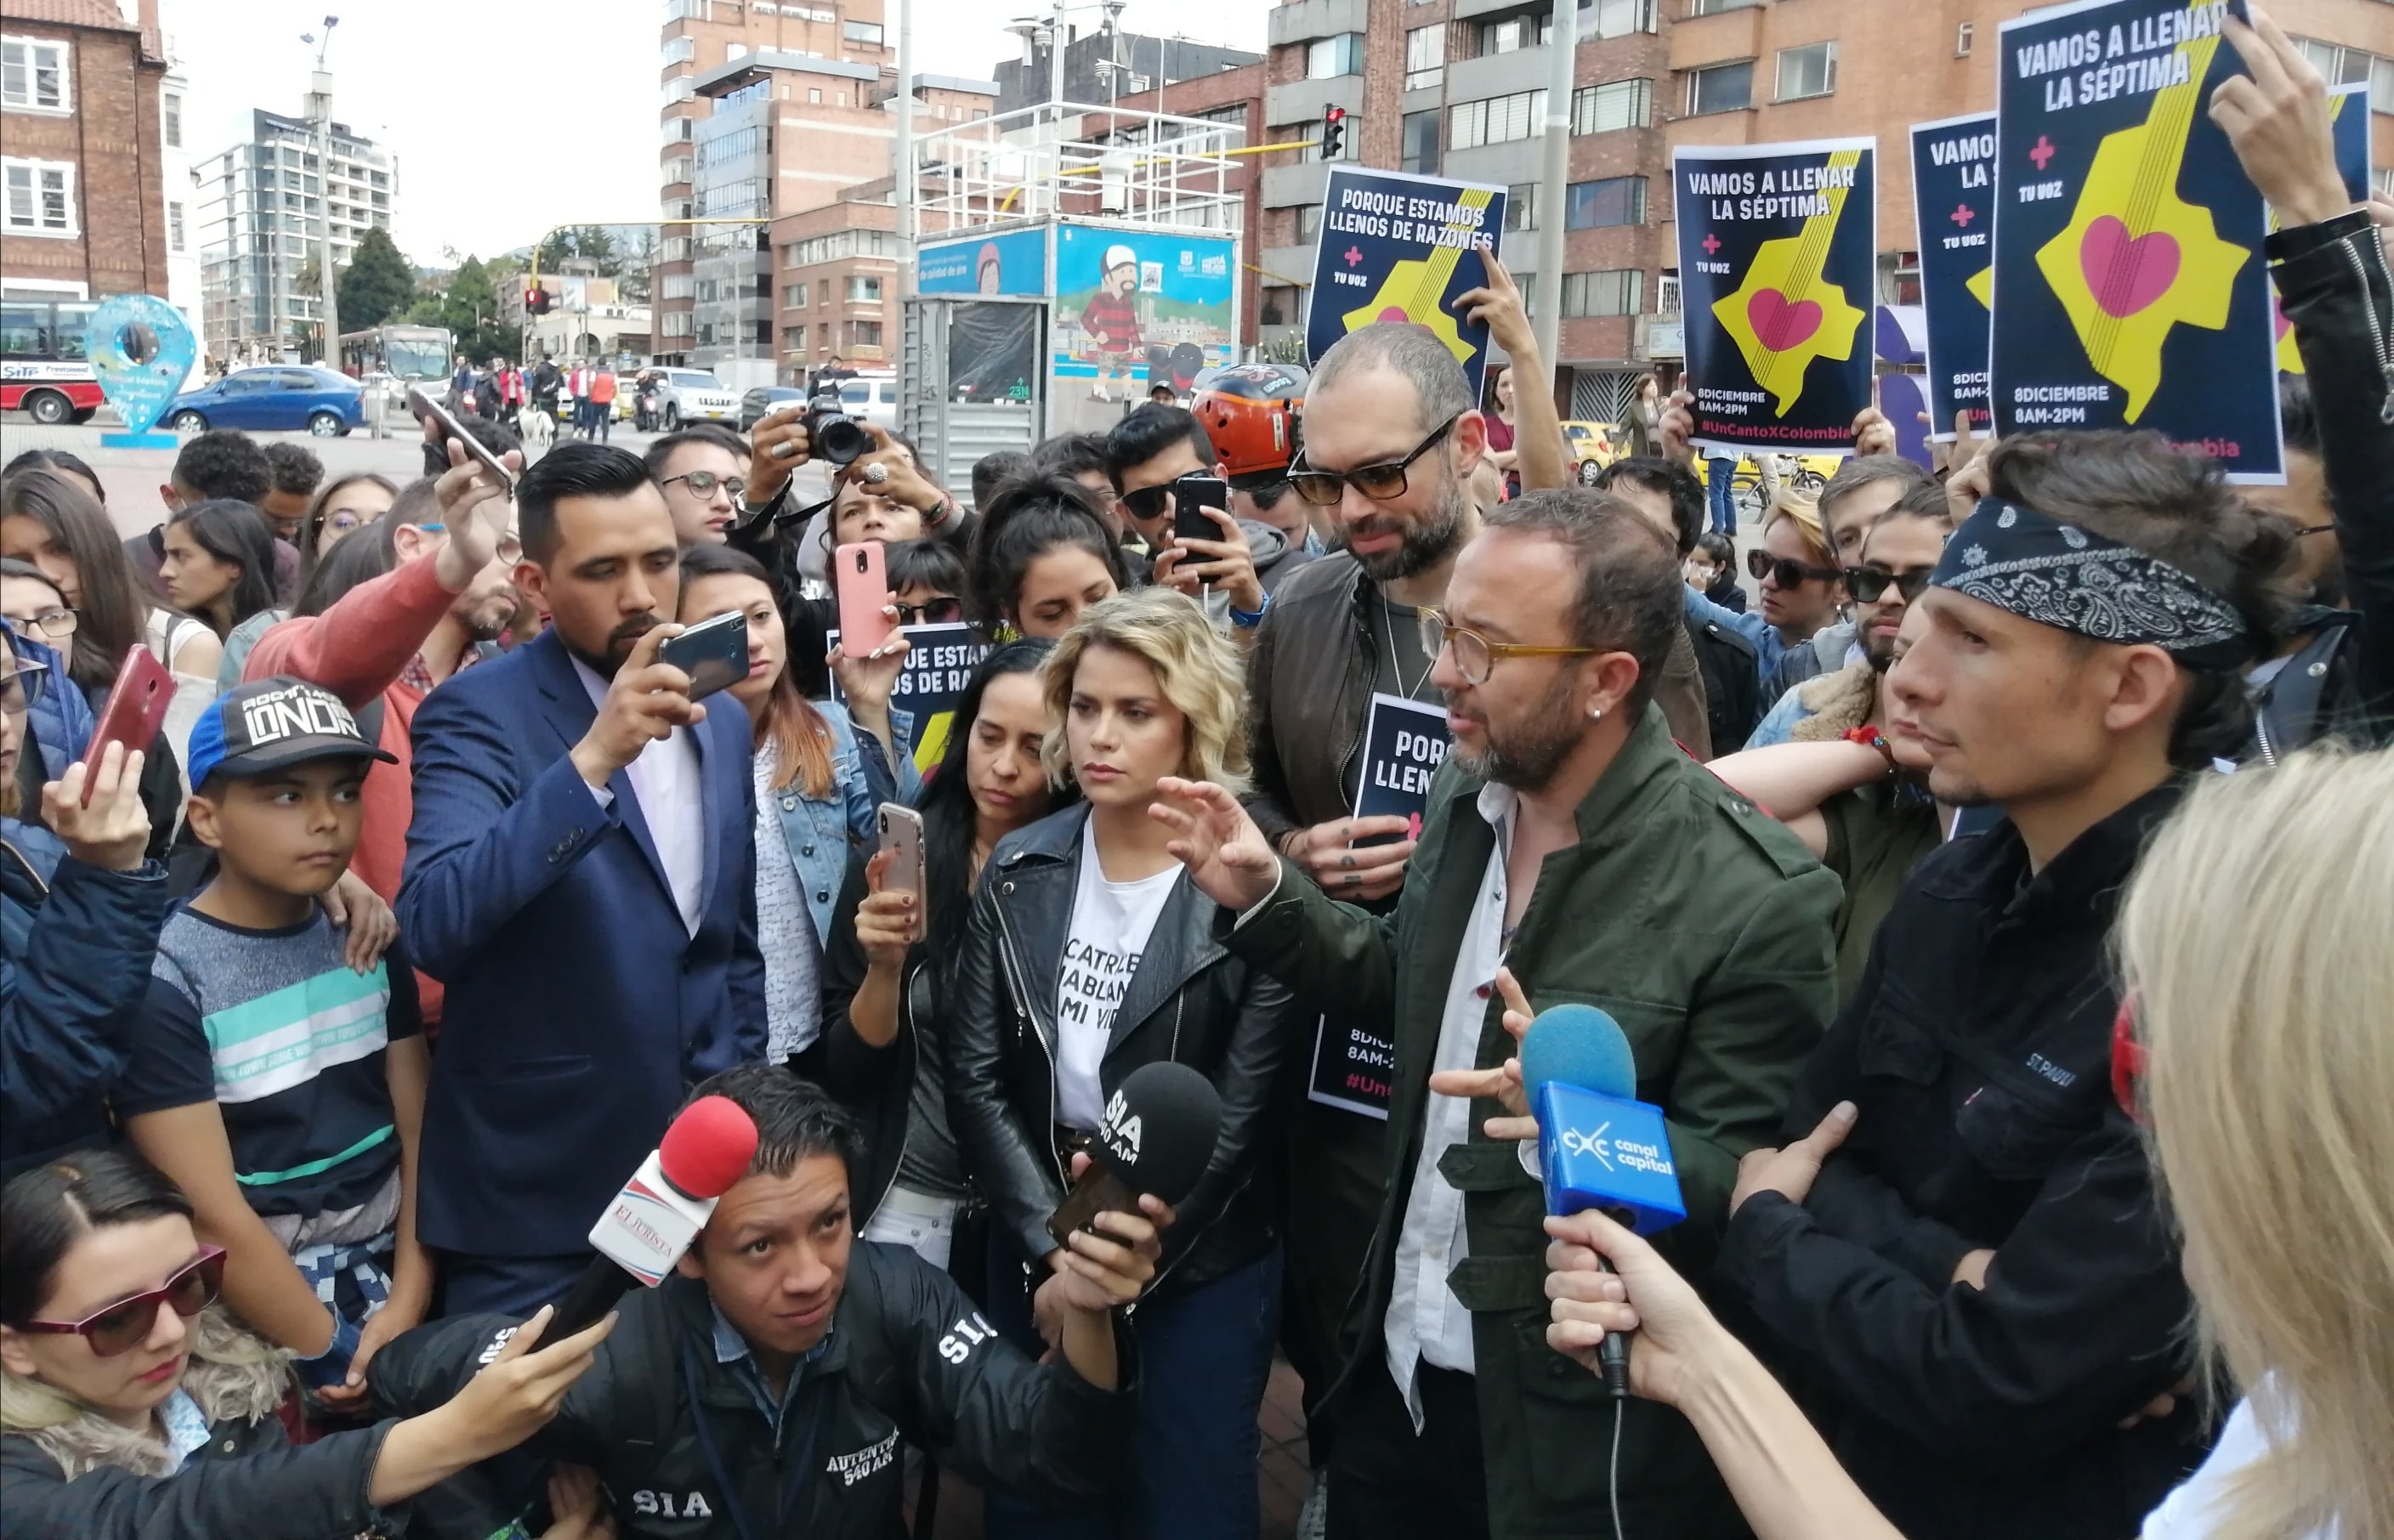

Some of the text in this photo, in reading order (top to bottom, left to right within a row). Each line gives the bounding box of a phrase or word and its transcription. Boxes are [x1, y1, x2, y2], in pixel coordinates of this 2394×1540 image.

[2017, 29, 2101, 79] VAMOS
[2106, 24, 2125, 59] A
[2045, 51, 2190, 113] LA SÉPTIMA
[1931, 134, 1994, 166] VAMO
[1688, 165, 1856, 195] VAMOS A LLENAR
[1961, 163, 1988, 189] LA
[2018, 185, 2035, 203] TU
[1342, 188, 1486, 228] PORQUE ESTAMOS
[1711, 194, 1830, 221] LA SÉPTIMA
[1329, 211, 1494, 252] LLENOS DE RAZONES
[1943, 236, 1960, 250] TU
[1334, 271, 1347, 285] TU
[1696, 261, 1708, 274] TU
[46, 365, 88, 374] Provisional
[1953, 372, 1989, 385] 8DICI
[1698, 388, 1765, 404] 8DICIEMBRE
[1954, 386, 1989, 399] 8AM-2
[2014, 385, 2109, 403] 8DICIEMBRE
[1699, 400, 1748, 416] 8AM-2PM
[2015, 407, 2085, 423] 8AM-2PM
[1702, 420, 1851, 440] #UnCantoXColombia
[934, 644, 992, 668] ESTAM
[918, 671, 943, 694] DE
[1395, 730, 1447, 766] POR
[1375, 760, 1433, 795] LLEN
[1060, 995, 1119, 1030] MI VI
[1347, 1046, 1394, 1070] 8AM-2
[1106, 1088, 1142, 1152] SIA
[1110, 1140, 1138, 1167] AM
[1614, 1139, 1659, 1158] canal
[1617, 1152, 1673, 1176] capital
[844, 1447, 893, 1487] 540 AM
[633, 1488, 713, 1518] SIA
